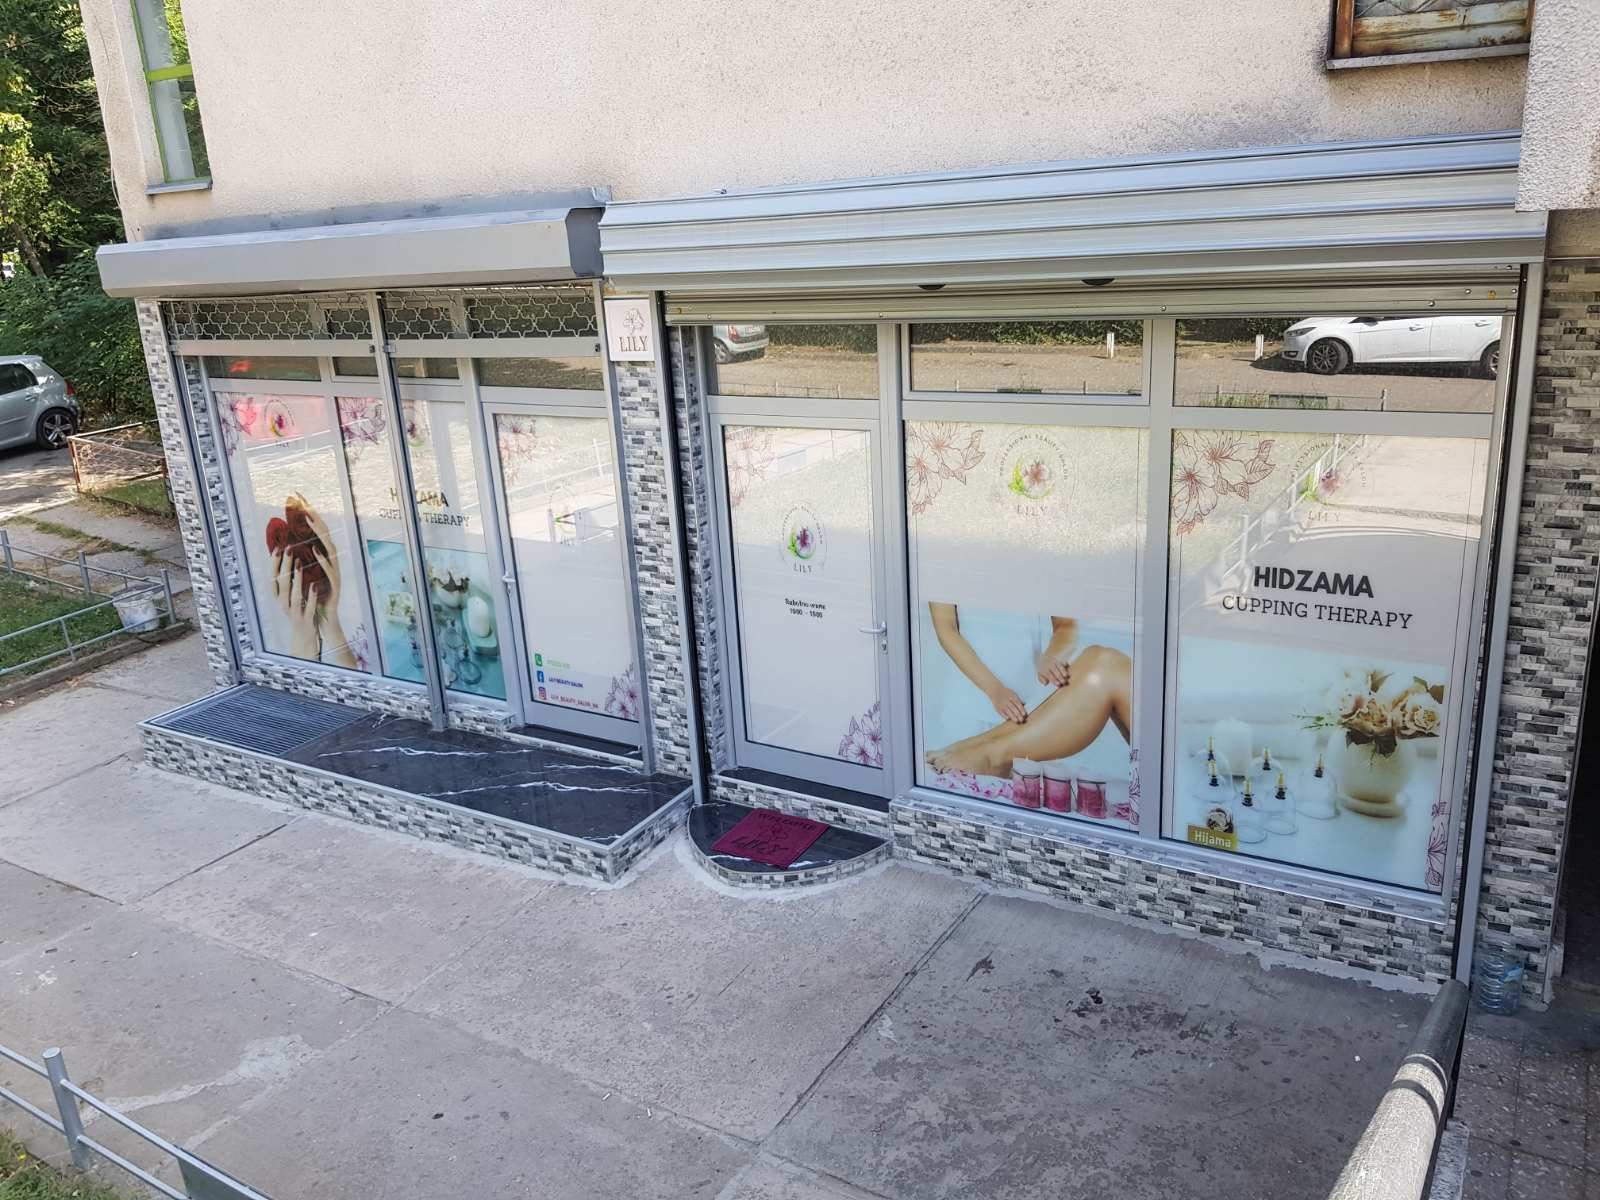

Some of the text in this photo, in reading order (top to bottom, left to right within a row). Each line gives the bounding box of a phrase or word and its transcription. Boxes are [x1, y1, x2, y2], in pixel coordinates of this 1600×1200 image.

[619, 335, 648, 352] LILY
[390, 487, 449, 507] HAMA
[423, 512, 470, 527] THERAPY
[1253, 565, 1374, 598] HIDZAMA
[1222, 595, 1413, 629] CUPPING THERAPY
[1194, 830, 1233, 848] Hijama
